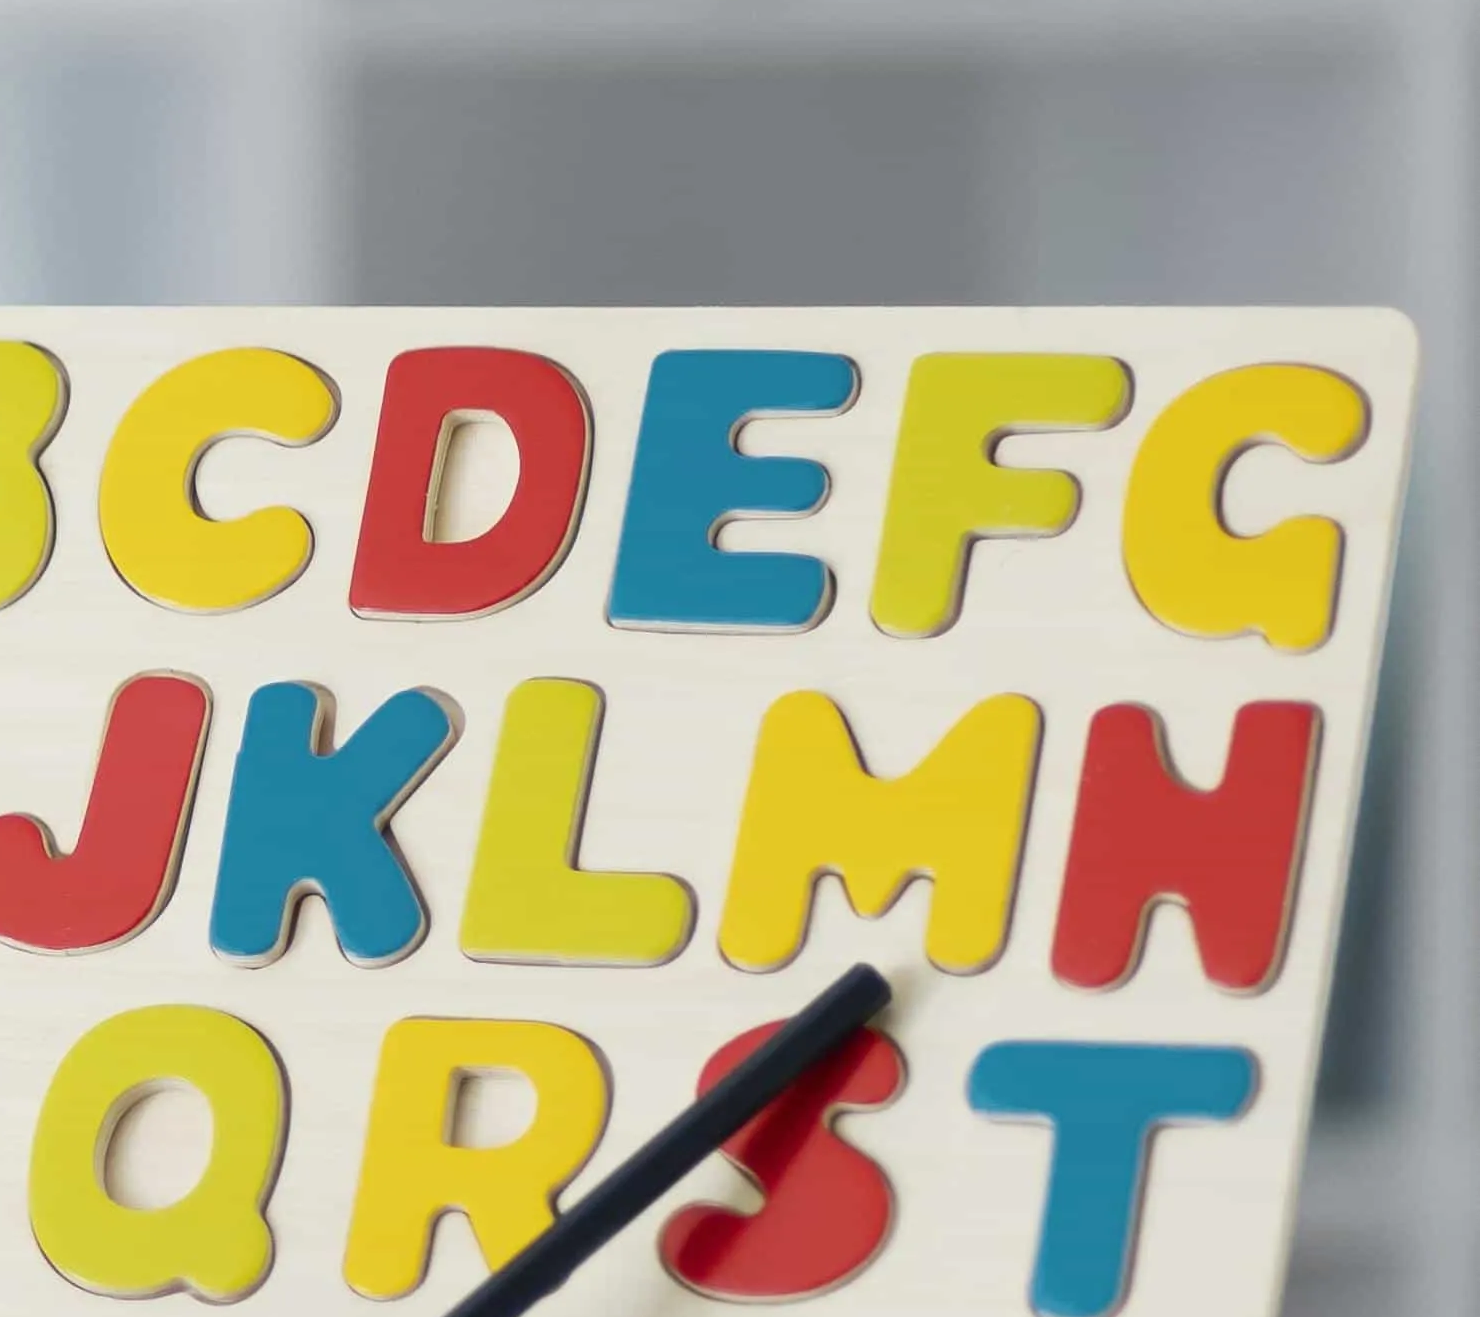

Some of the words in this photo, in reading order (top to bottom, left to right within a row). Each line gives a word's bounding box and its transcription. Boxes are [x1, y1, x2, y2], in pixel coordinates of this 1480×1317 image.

[99, 347, 336, 611] C
[349, 346, 588, 618] D
[609, 349, 856, 628] E
[871, 353, 1128, 635] F
[1121, 364, 1367, 649] G
[210, 682, 454, 963] K
[460, 678, 692, 964] L
[718, 689, 1041, 973] M
[1052, 702, 1317, 990] N
[29, 1005, 286, 1300] Q
[343, 1017, 611, 1300] R
